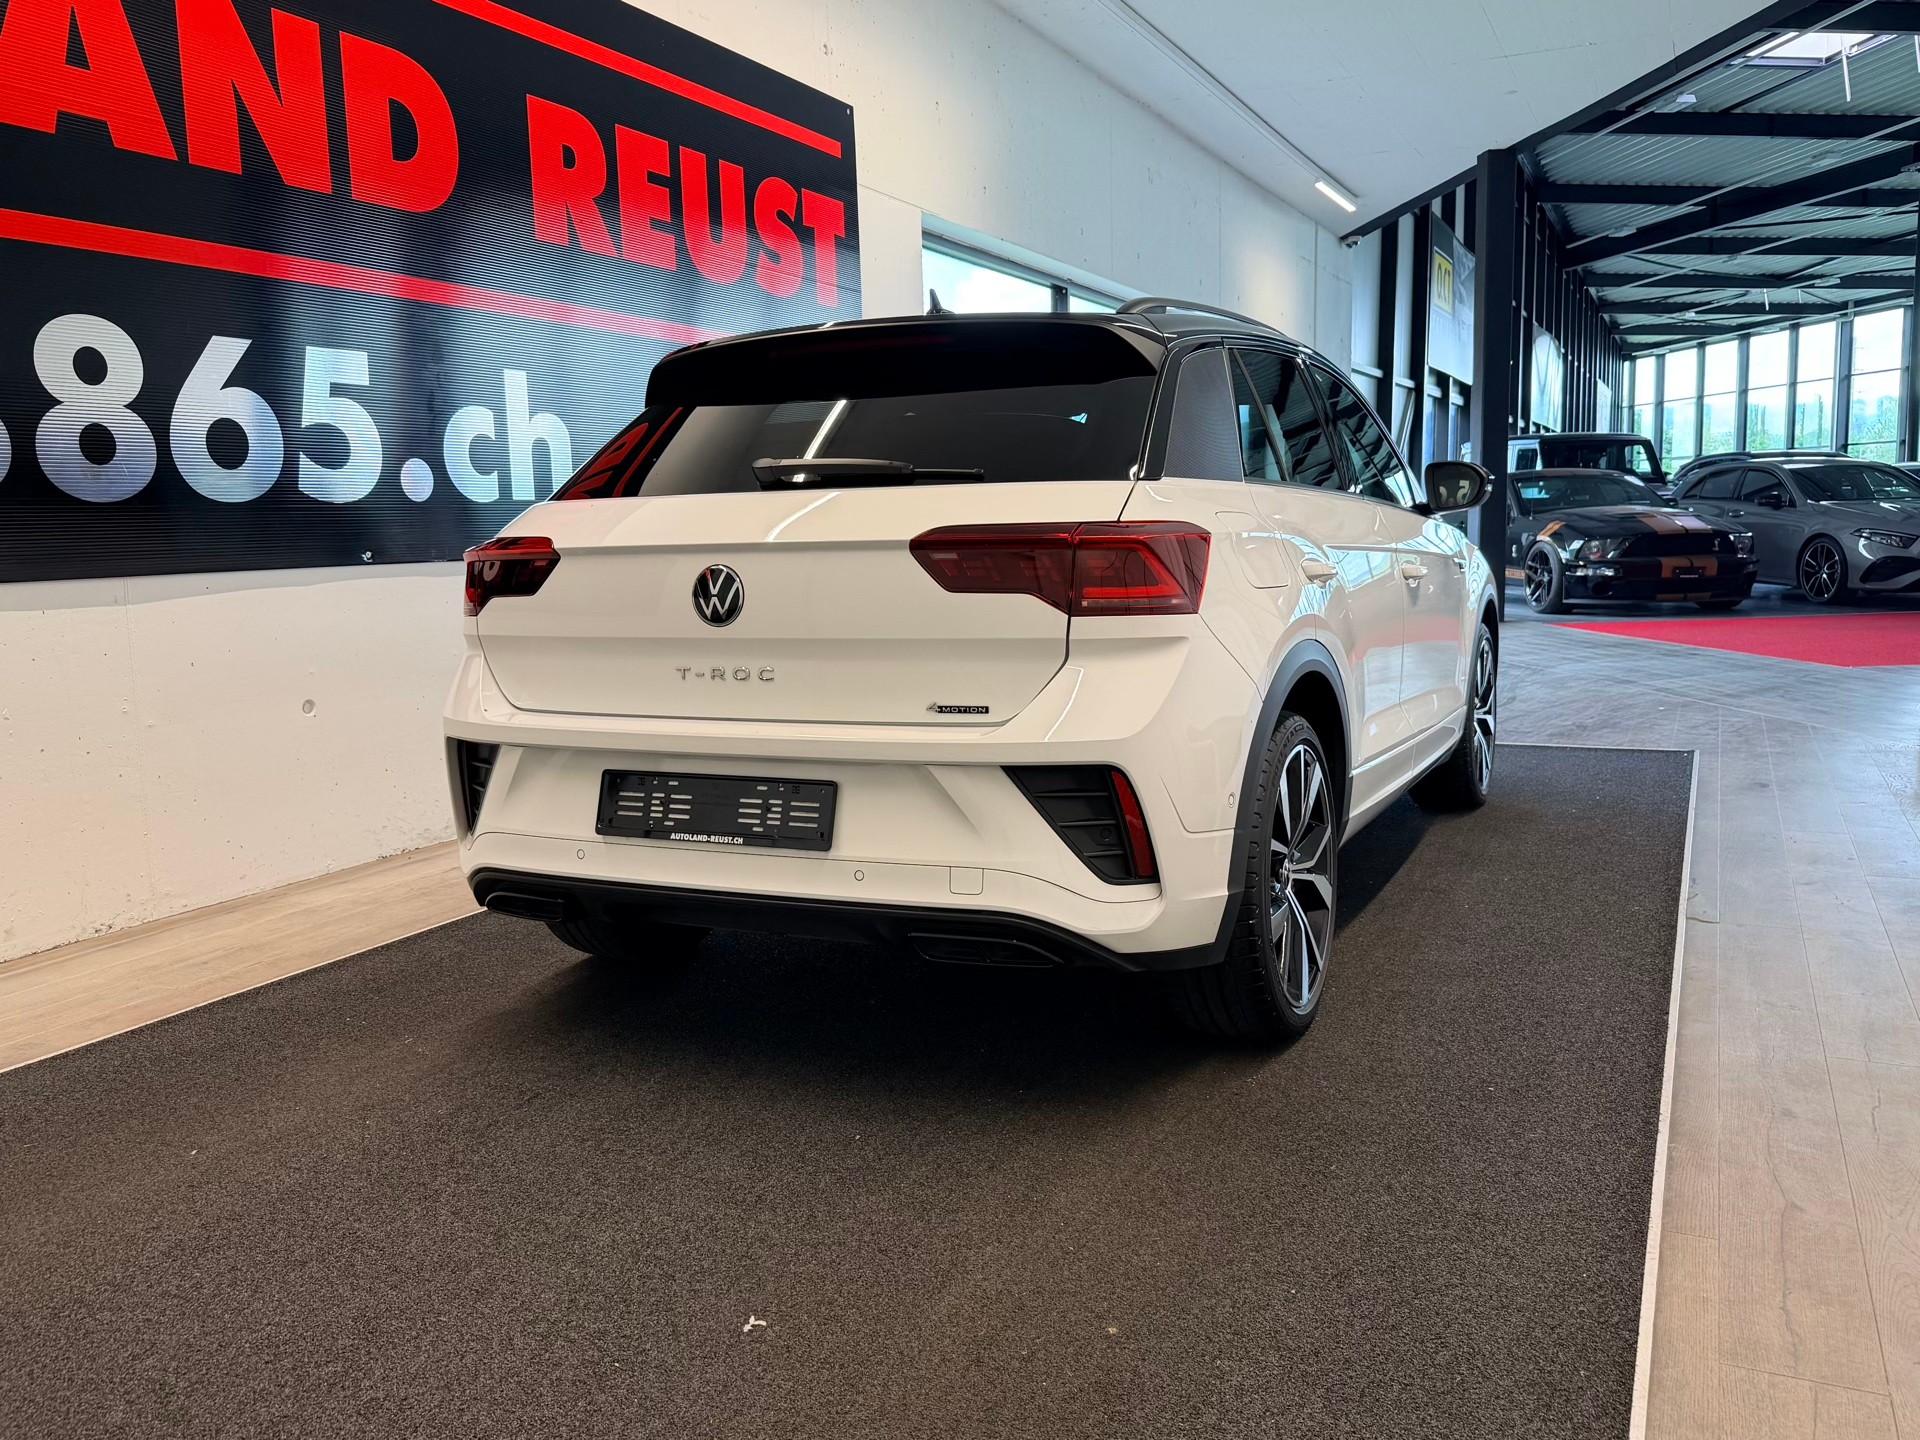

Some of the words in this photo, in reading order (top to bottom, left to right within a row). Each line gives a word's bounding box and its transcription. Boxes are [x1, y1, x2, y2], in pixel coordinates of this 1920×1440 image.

[0, 0, 459, 213] AND
[526, 94, 845, 308] REUST
[0, 313, 573, 503] 865.ch
[676, 666, 775, 681] T-ROC
[670, 832, 744, 845] AUTOLAND-REUST.CH
